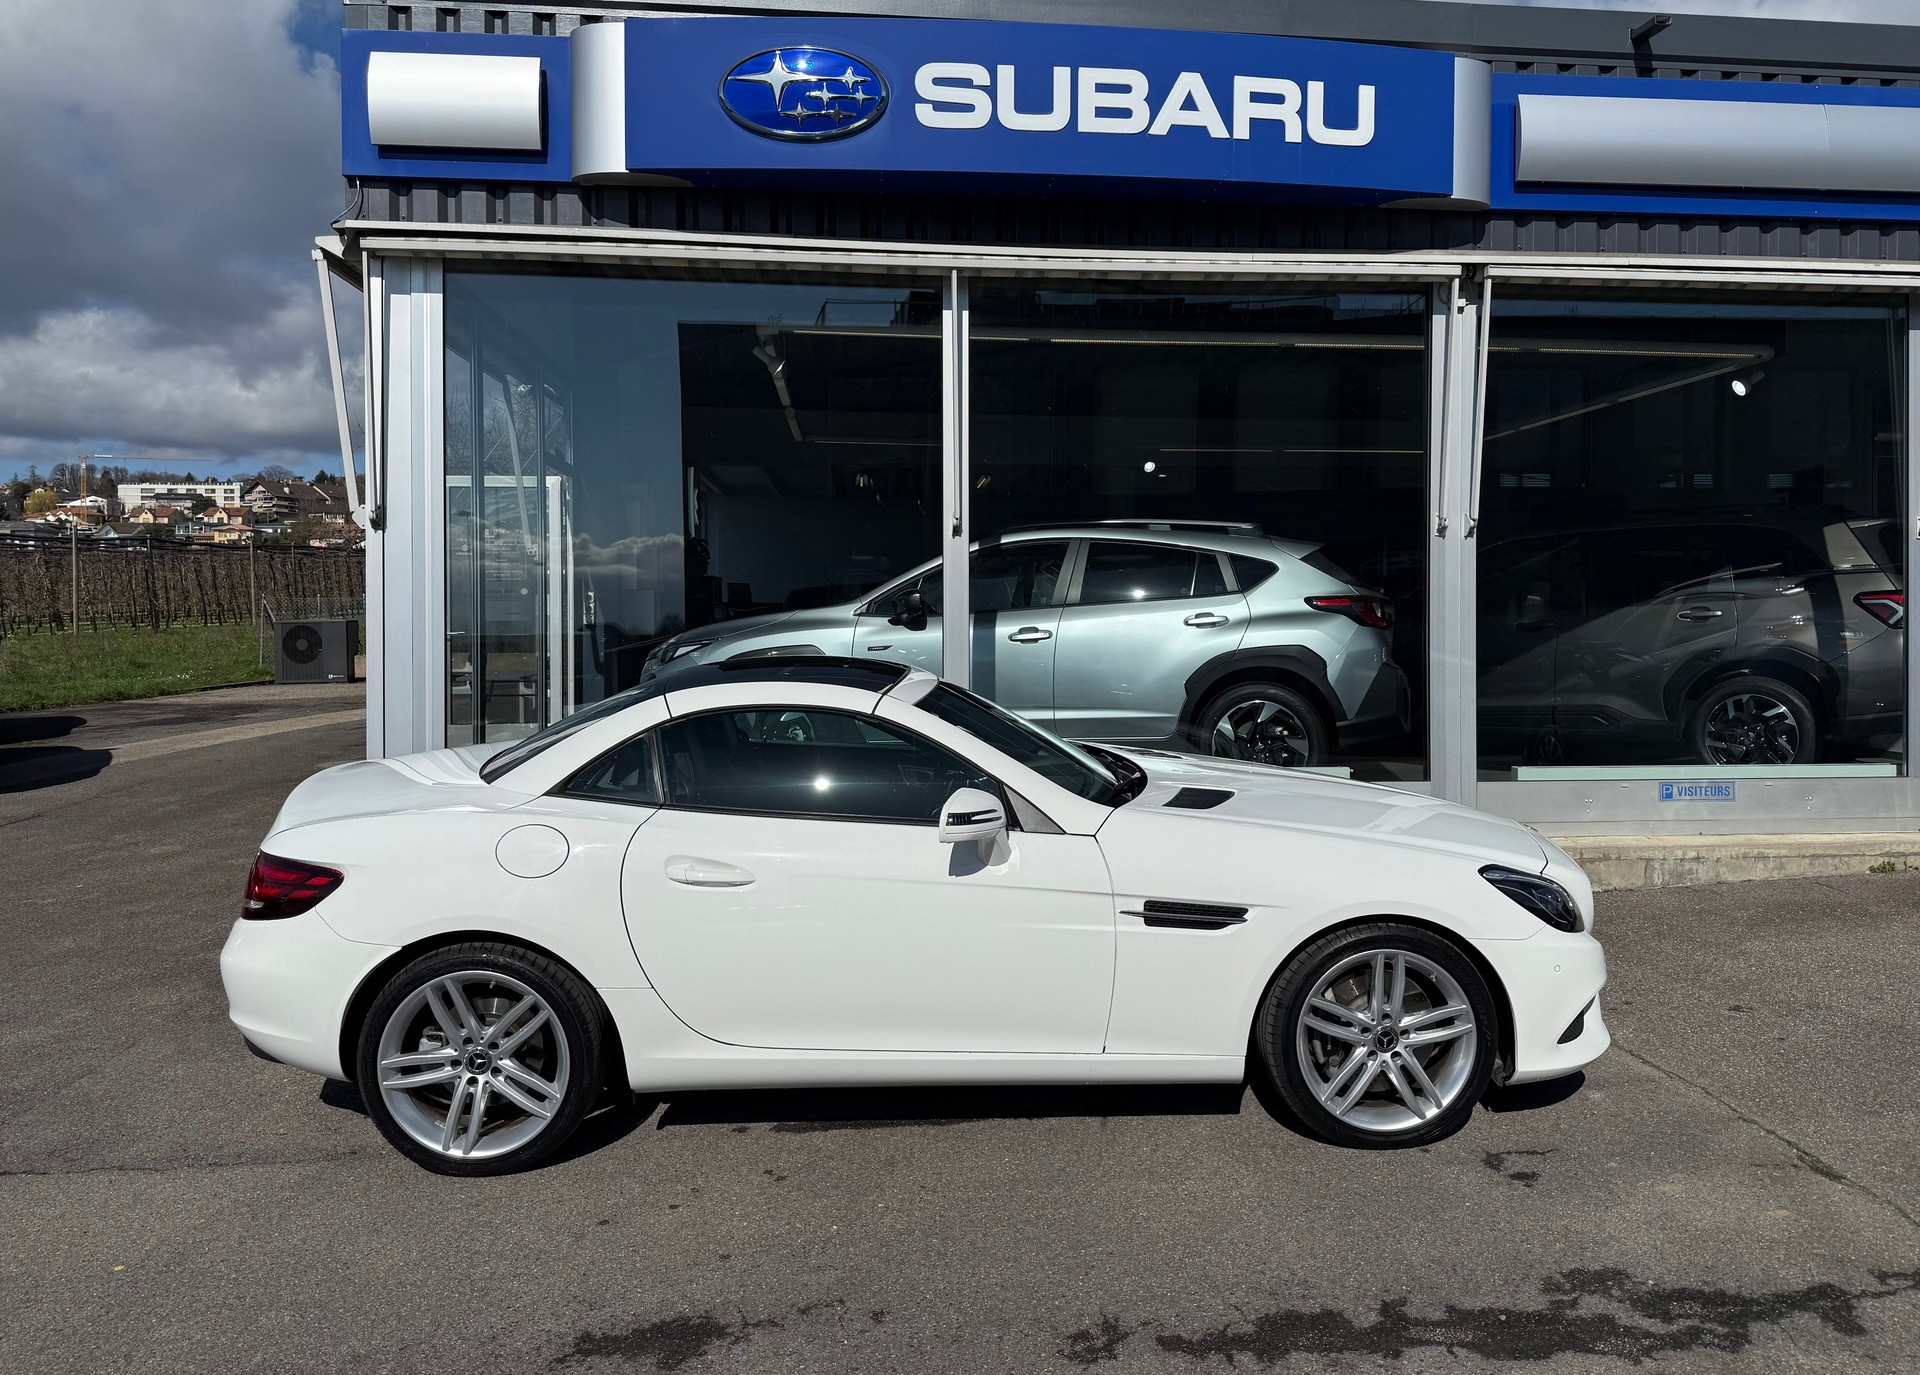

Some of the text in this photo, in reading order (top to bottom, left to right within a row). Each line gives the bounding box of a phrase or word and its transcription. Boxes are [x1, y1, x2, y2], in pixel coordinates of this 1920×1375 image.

[914, 62, 1376, 147] SUBARU
[1663, 785, 1731, 798] P VISITEURS
